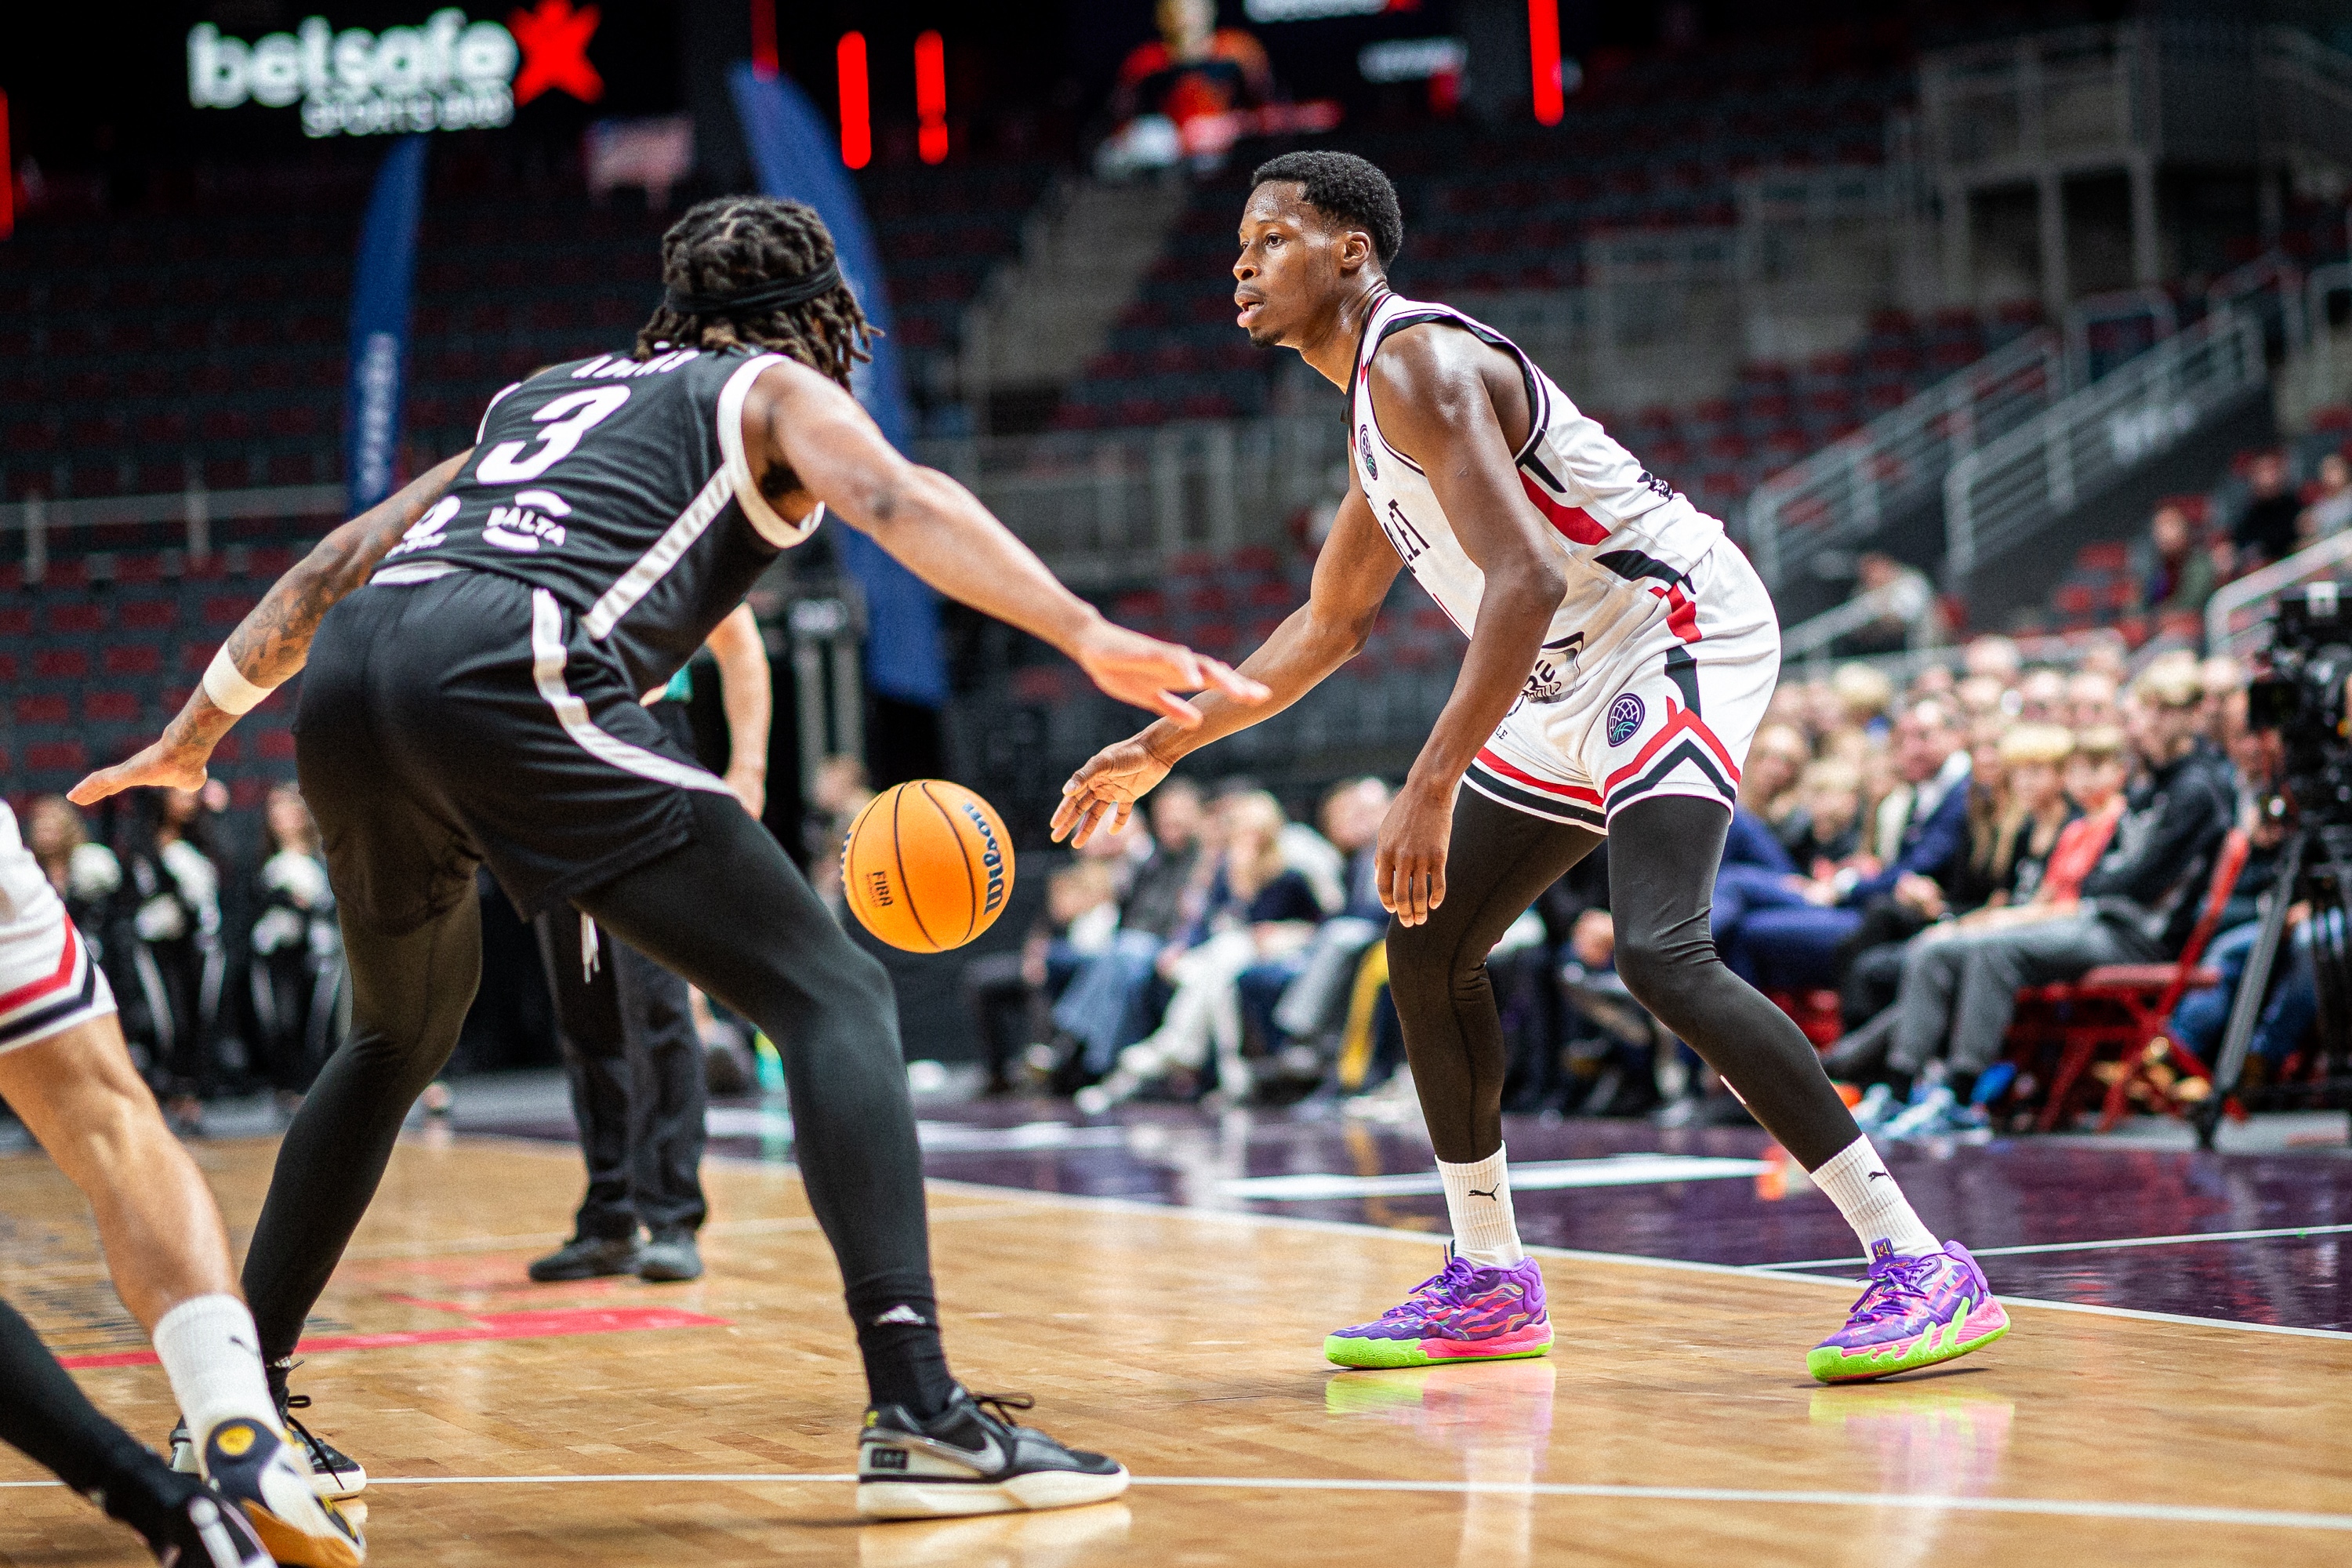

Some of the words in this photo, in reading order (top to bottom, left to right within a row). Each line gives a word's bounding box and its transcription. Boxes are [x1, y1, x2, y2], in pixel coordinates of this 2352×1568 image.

[476, 384, 631, 485] 3
[486, 506, 566, 547] BALTA
[873, 871, 893, 906] FIBA
[963, 802, 1004, 916] Wilson
